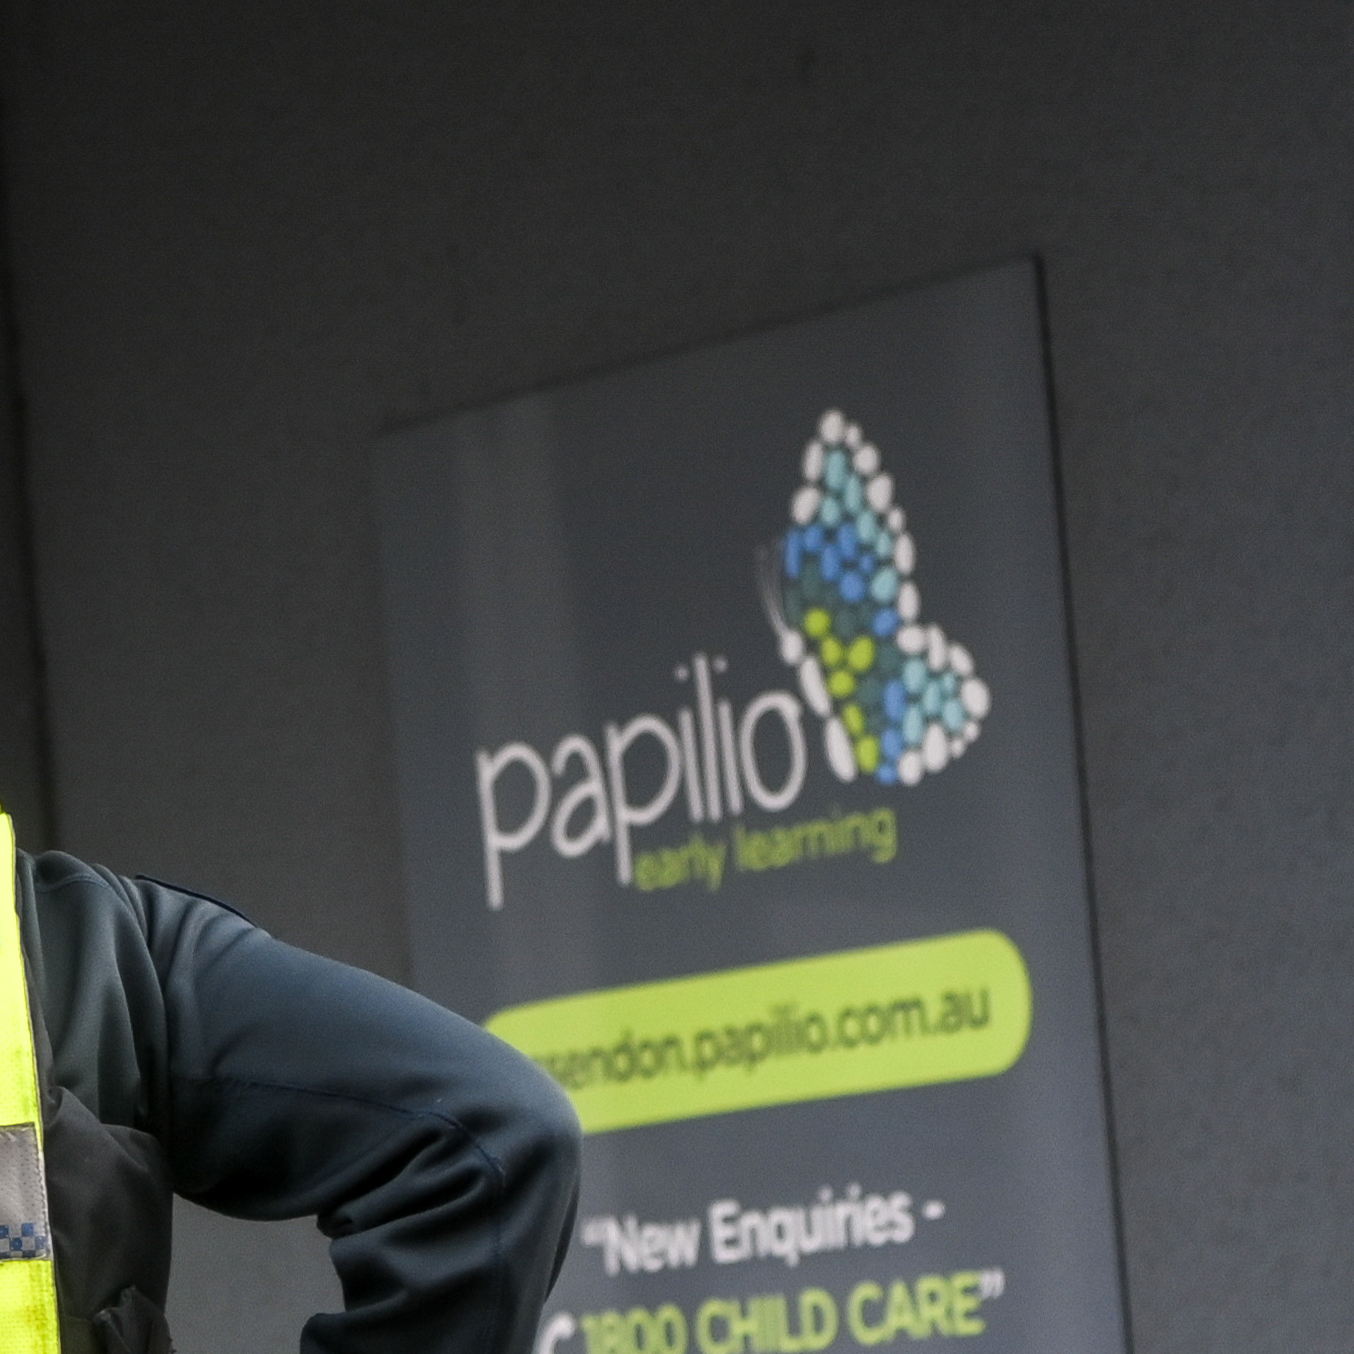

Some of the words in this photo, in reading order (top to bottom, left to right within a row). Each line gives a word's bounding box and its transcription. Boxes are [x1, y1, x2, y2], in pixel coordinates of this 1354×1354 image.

[477, 652, 807, 910] papilio
[633, 832, 726, 891] early
[732, 806, 897, 872] learning
[708, 1183, 915, 1267] Enquiries
